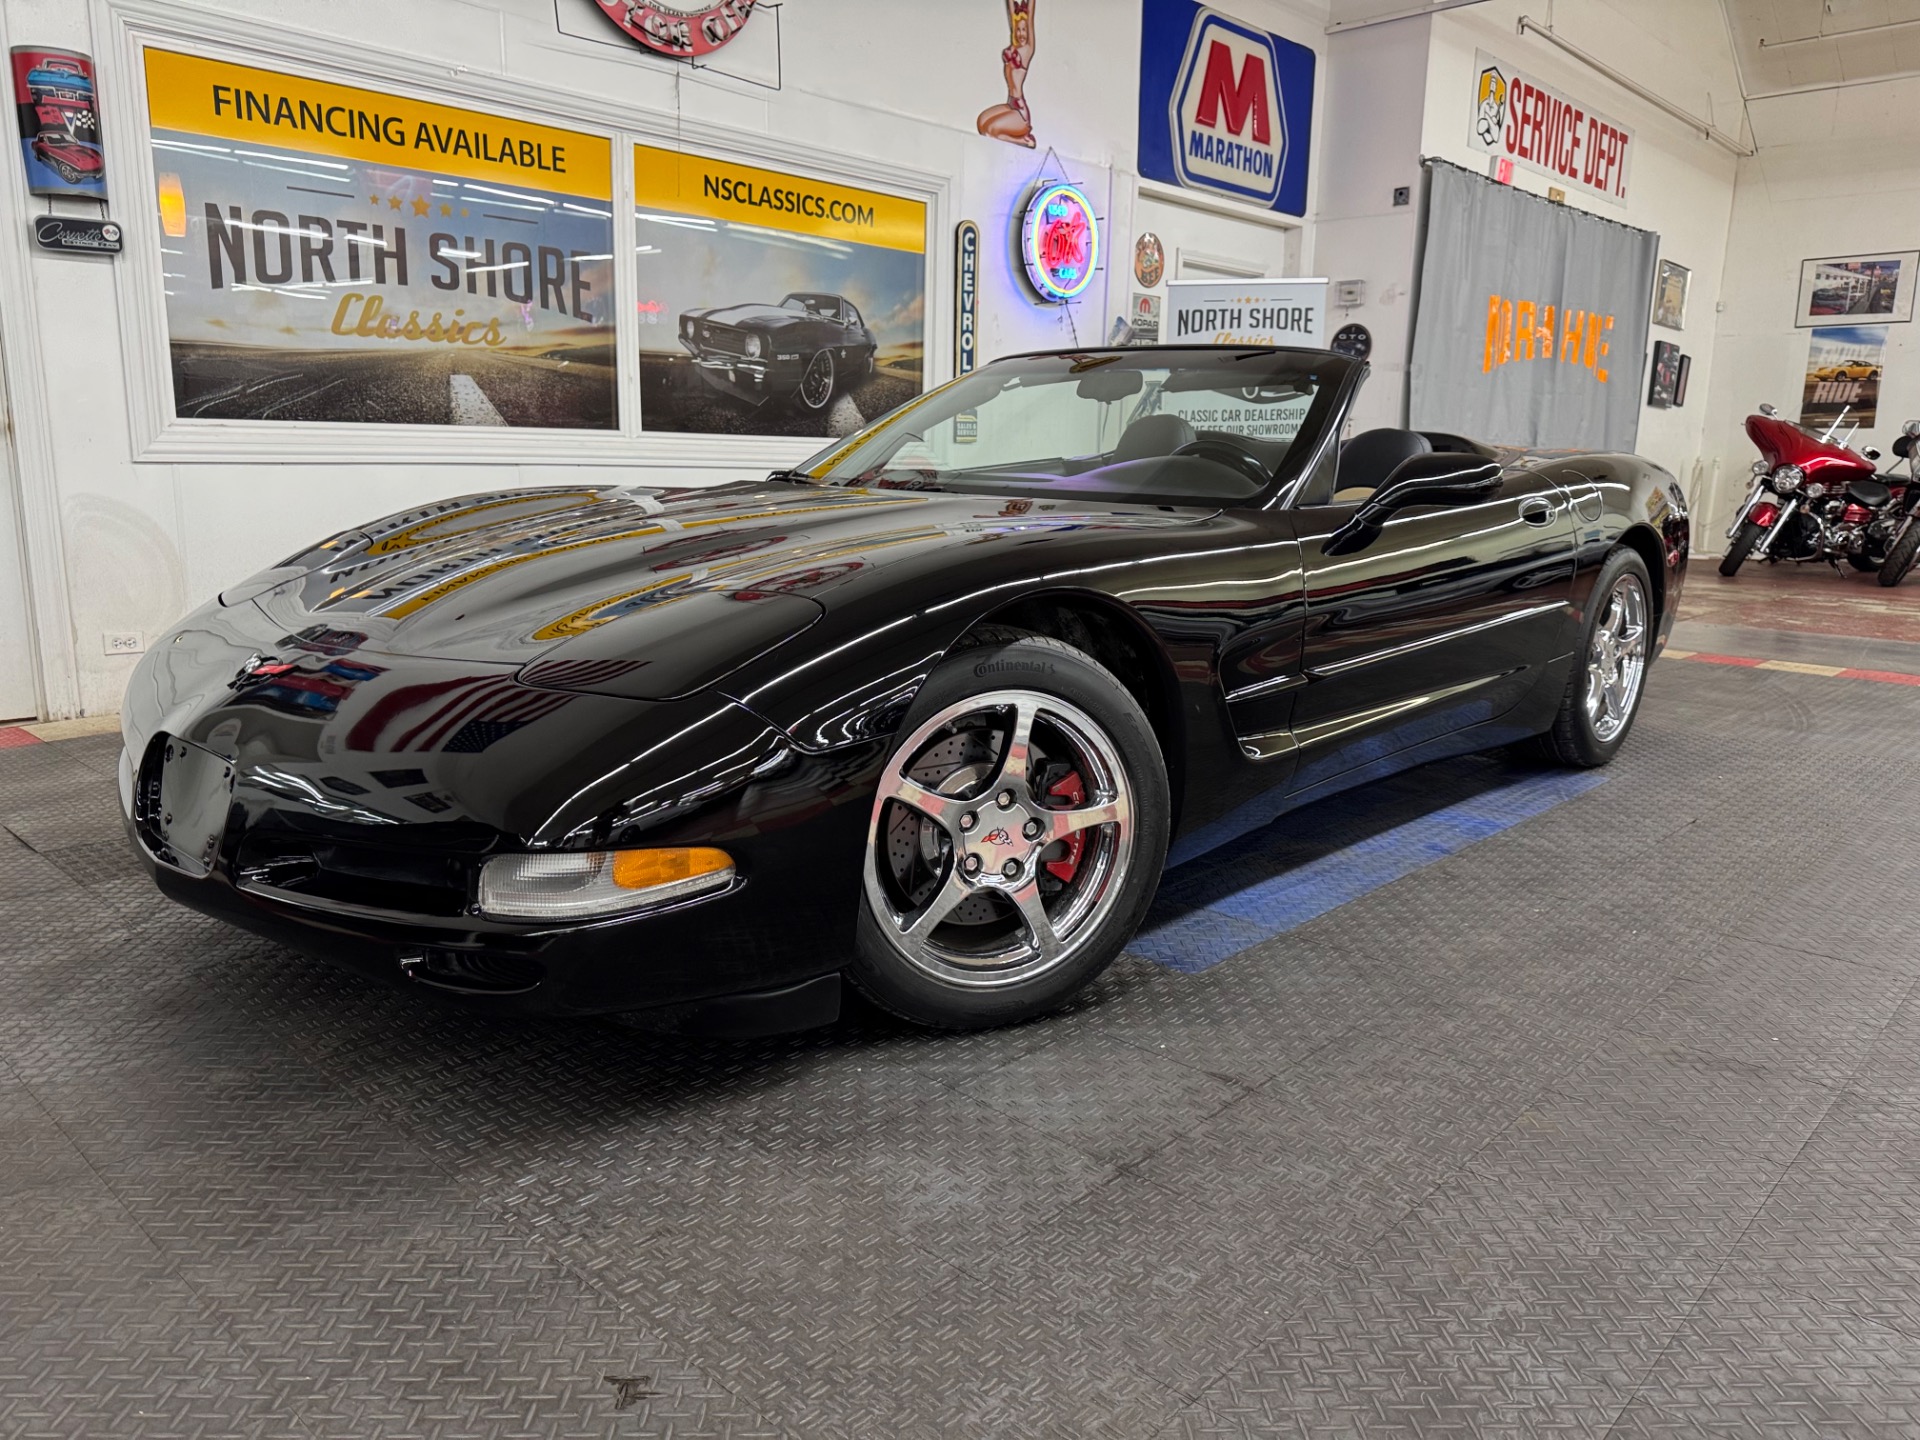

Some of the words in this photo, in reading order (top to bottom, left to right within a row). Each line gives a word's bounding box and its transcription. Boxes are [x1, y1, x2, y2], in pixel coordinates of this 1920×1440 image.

[212, 84, 406, 147] FINANCING
[413, 123, 567, 174] AVAILABLE
[1505, 77, 1584, 180] SERVICE
[1583, 117, 1630, 200] DEPT.
[1188, 130, 1274, 179] MARATHON
[703, 174, 876, 229] NSCLASSICS.COM
[38, 221, 104, 243] Corvette
[203, 202, 410, 290] NORTH
[428, 231, 595, 324] SHORE
[1141, 266, 1160, 284] BEE
[961, 231, 976, 377] CHEVROL
[330, 292, 508, 347] Classics
[1132, 318, 1159, 328] MOPAR
[1177, 307, 1242, 337] NORTH
[1248, 307, 1314, 334] SHORE
[1811, 381, 1864, 404] RIDE
[1178, 409, 1218, 423] CLASSIC
[1221, 409, 1241, 422] CAR
[1244, 408, 1306, 422] DEALERSHIP
[1226, 424, 1244, 435] OUR
[973, 659, 1046, 678] Continental
